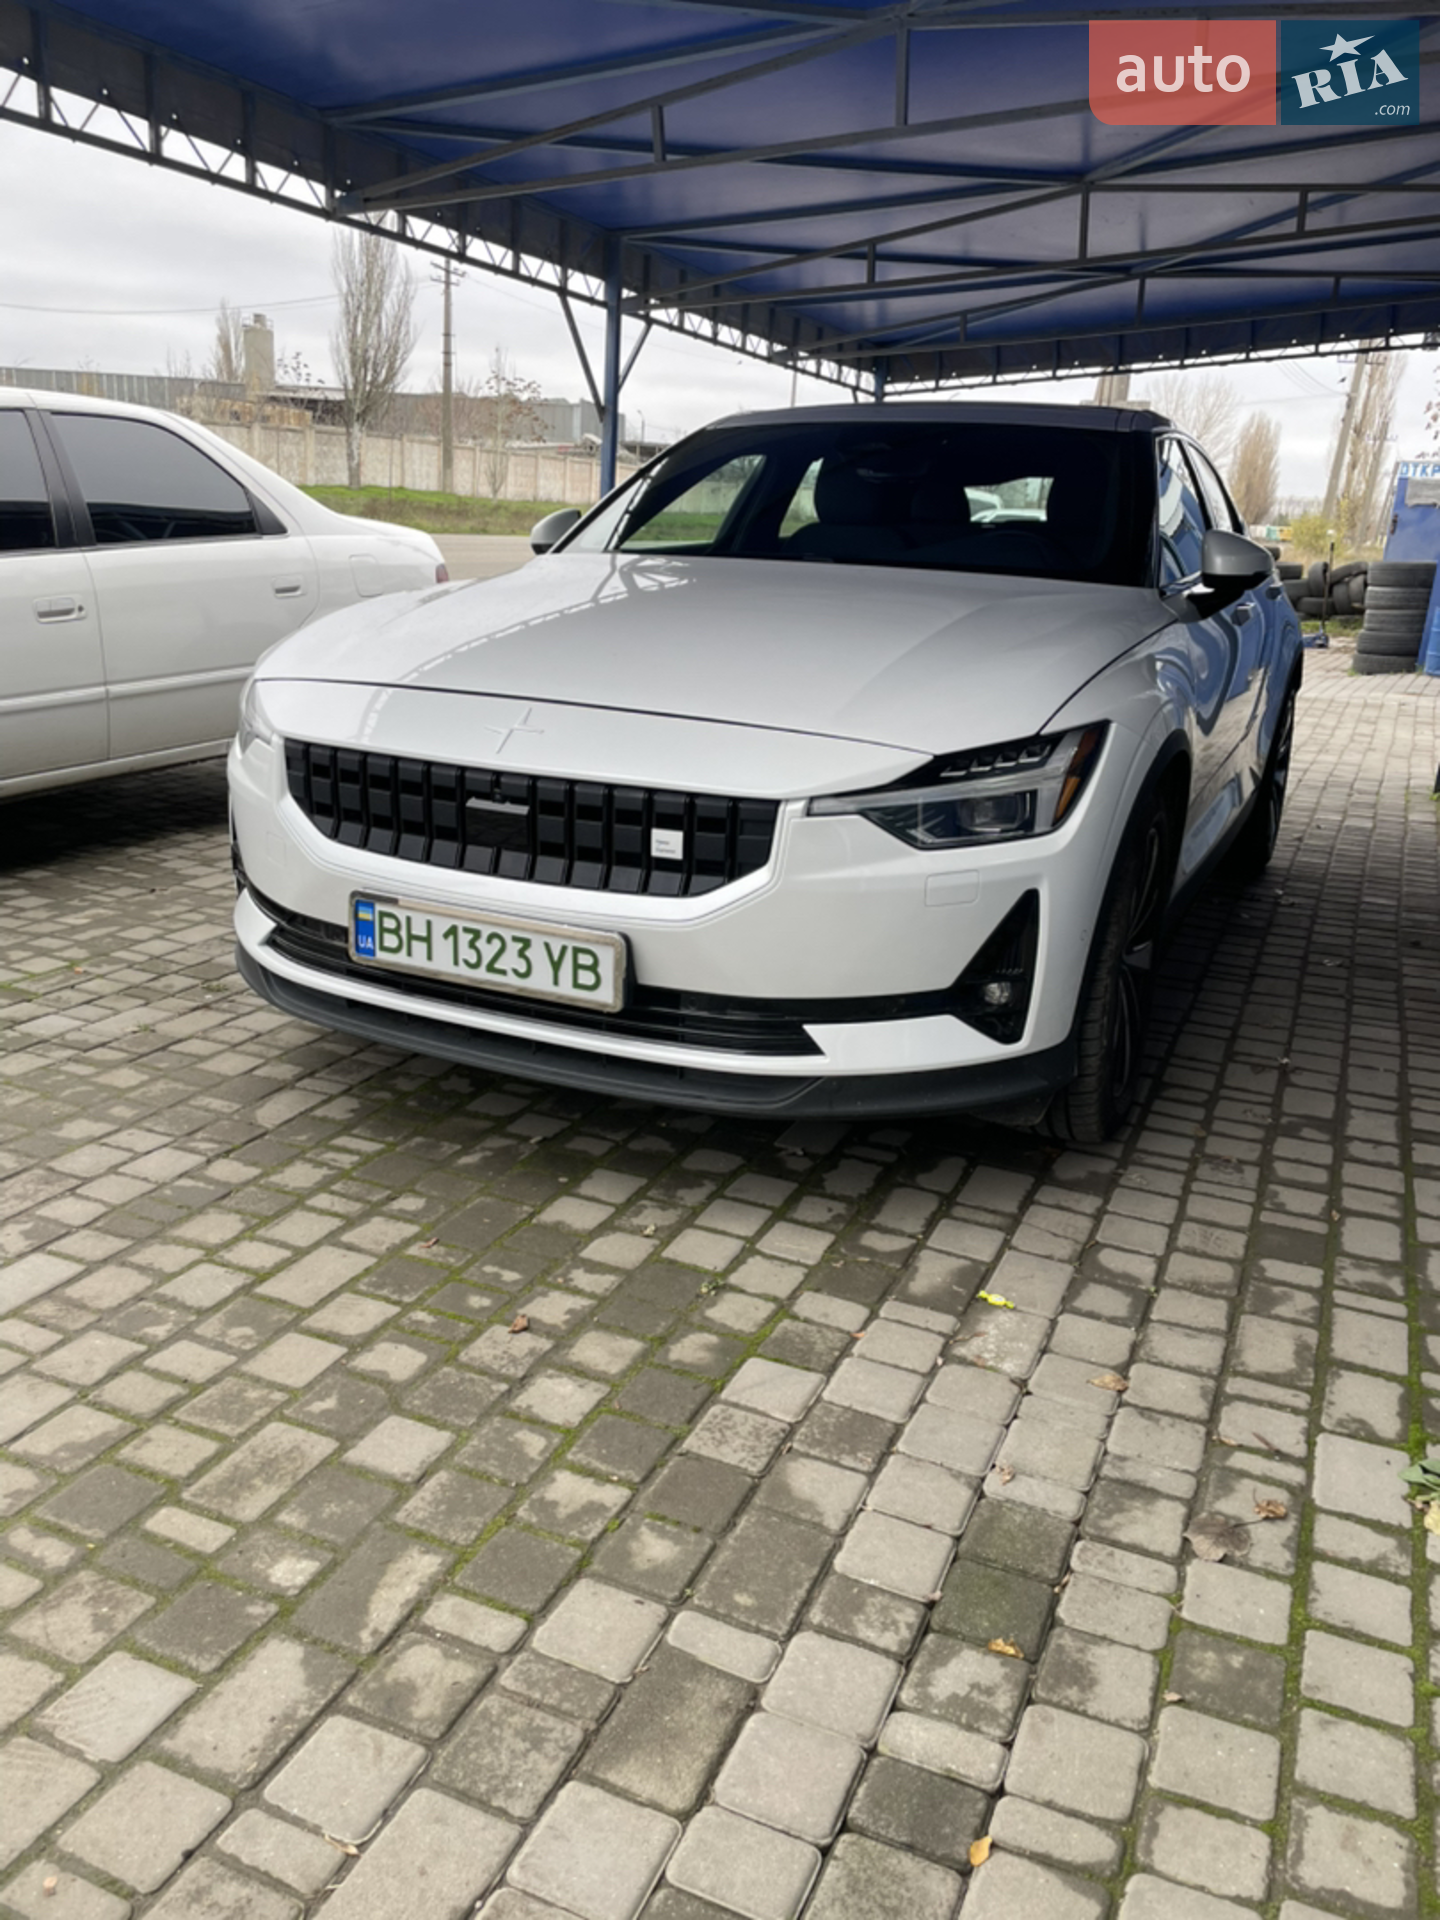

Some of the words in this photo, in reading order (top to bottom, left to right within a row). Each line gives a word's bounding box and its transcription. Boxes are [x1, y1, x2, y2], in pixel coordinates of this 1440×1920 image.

[357, 936, 374, 948] UA
[377, 910, 433, 961] BH
[442, 924, 533, 979] 1323
[543, 941, 602, 991] YB
